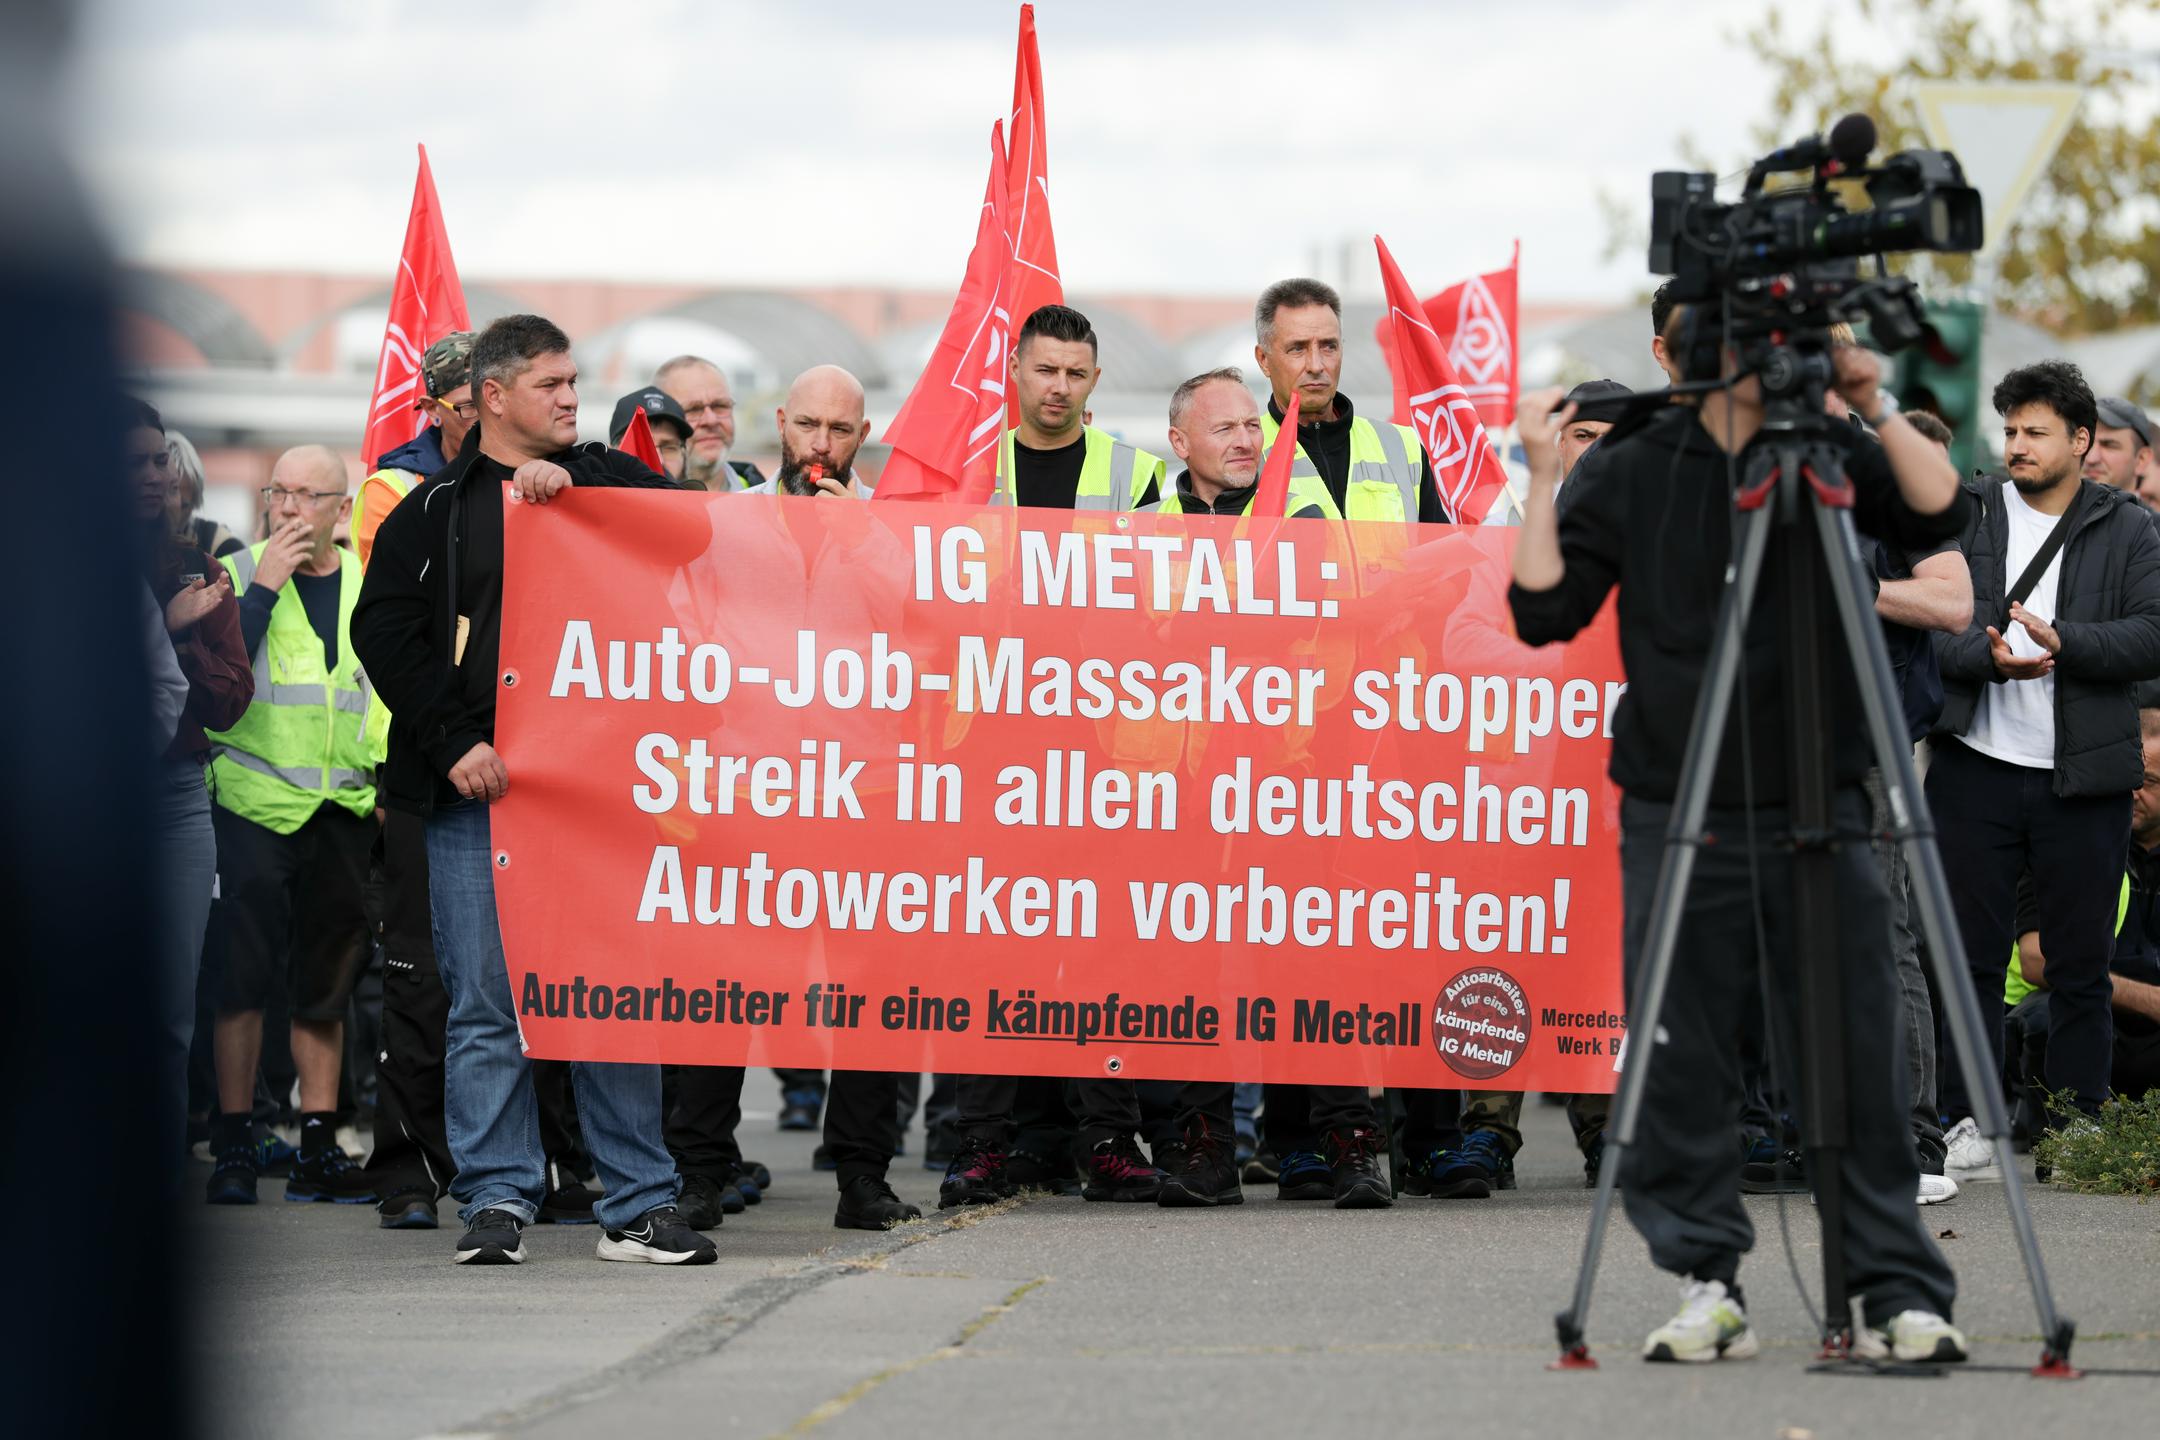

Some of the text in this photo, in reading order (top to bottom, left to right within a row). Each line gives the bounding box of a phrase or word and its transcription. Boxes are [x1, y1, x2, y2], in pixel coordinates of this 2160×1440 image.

[913, 525, 1339, 618] IG METALL:
[549, 619, 1325, 727] Auto-Job-Massaker
[632, 732, 1589, 846] Streik in allen deutschen
[636, 845, 1571, 954] Autowerken vorbereiten!
[521, 972, 1422, 1047] Autoarbeiter für eine kämpfende IG Metall
[1445, 972, 1526, 1016] Autoarbeiter
[1461, 993, 1508, 1016] für eine
[1435, 1007, 1526, 1043] kämpfende
[1440, 1036, 1512, 1067] IG Metall
[1556, 1035, 1602, 1055] Werk
